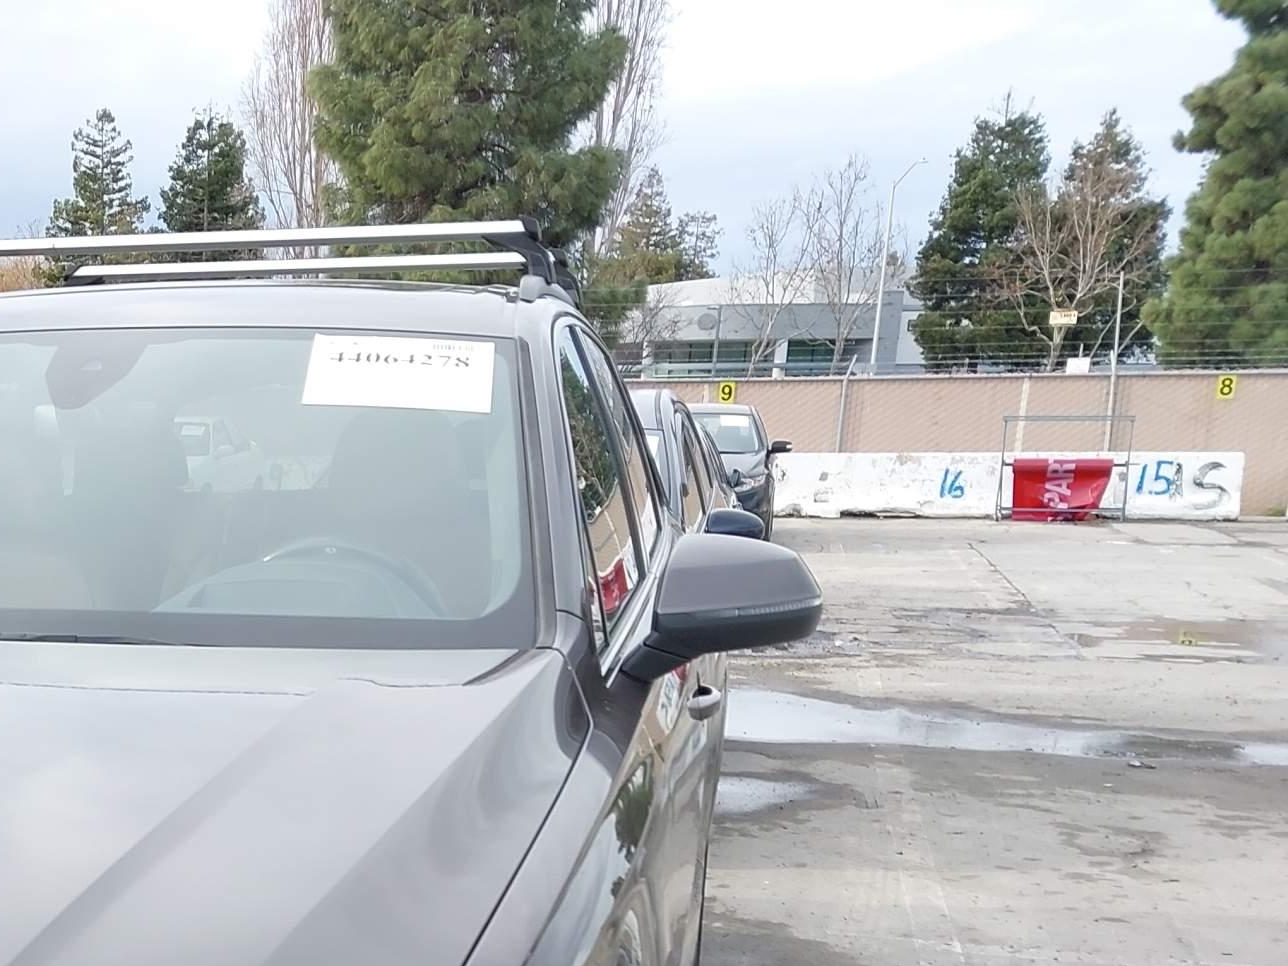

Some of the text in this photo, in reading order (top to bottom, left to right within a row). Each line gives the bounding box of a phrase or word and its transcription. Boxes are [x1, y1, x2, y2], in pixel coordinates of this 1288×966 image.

[329, 351, 470, 368] 44064278
[721, 384, 733, 401] 9
[1220, 377, 1234, 396] 8
[939, 468, 965, 498] 16
